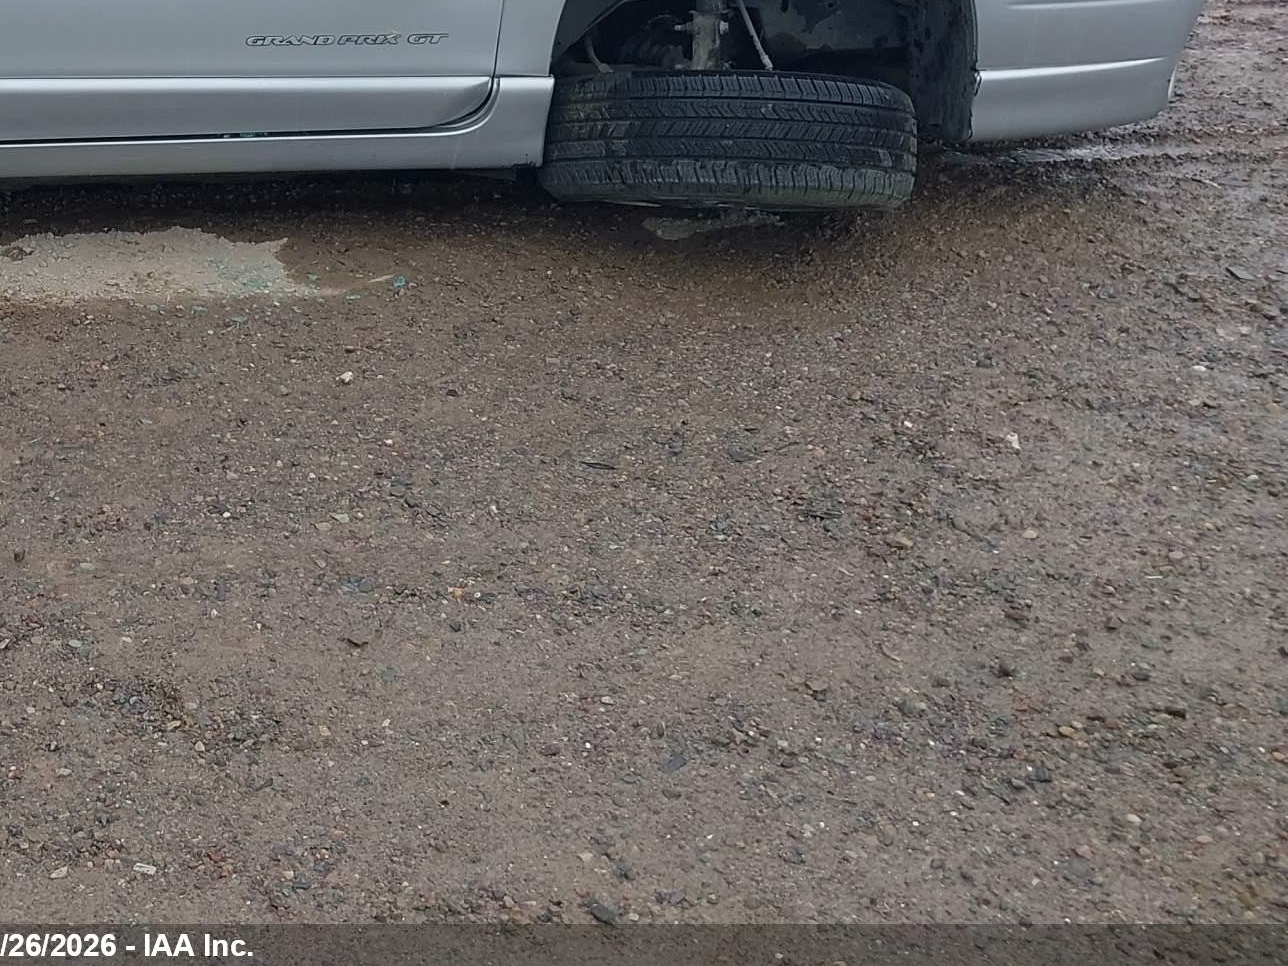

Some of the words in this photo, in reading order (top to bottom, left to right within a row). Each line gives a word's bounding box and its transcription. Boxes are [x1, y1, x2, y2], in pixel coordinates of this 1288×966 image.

[245, 34, 335, 46] GRAND
[337, 32, 401, 45] PRIX
[407, 33, 449, 45] GT
